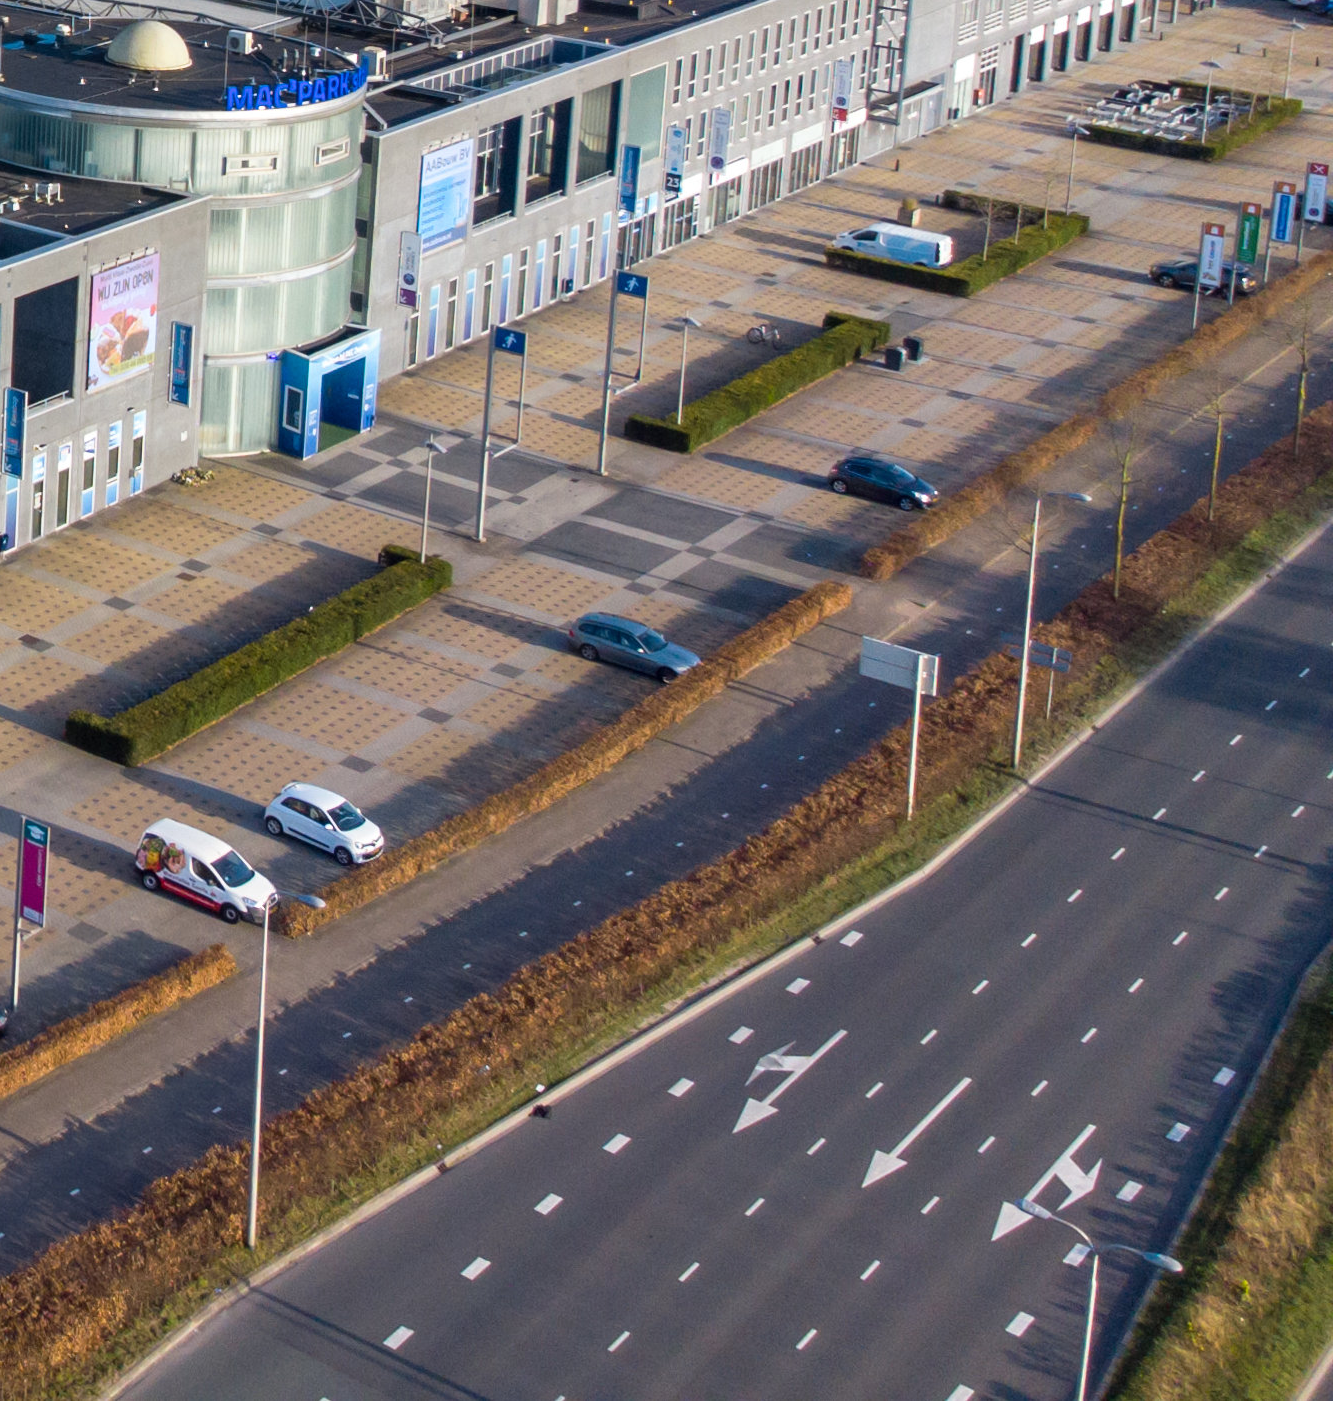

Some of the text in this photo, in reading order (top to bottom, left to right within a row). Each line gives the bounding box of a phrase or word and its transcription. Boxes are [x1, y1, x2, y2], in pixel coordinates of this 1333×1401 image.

[458, 145, 471, 161] BV
[666, 176, 680, 190] 23
[113, 277, 130, 297] ZIJN
